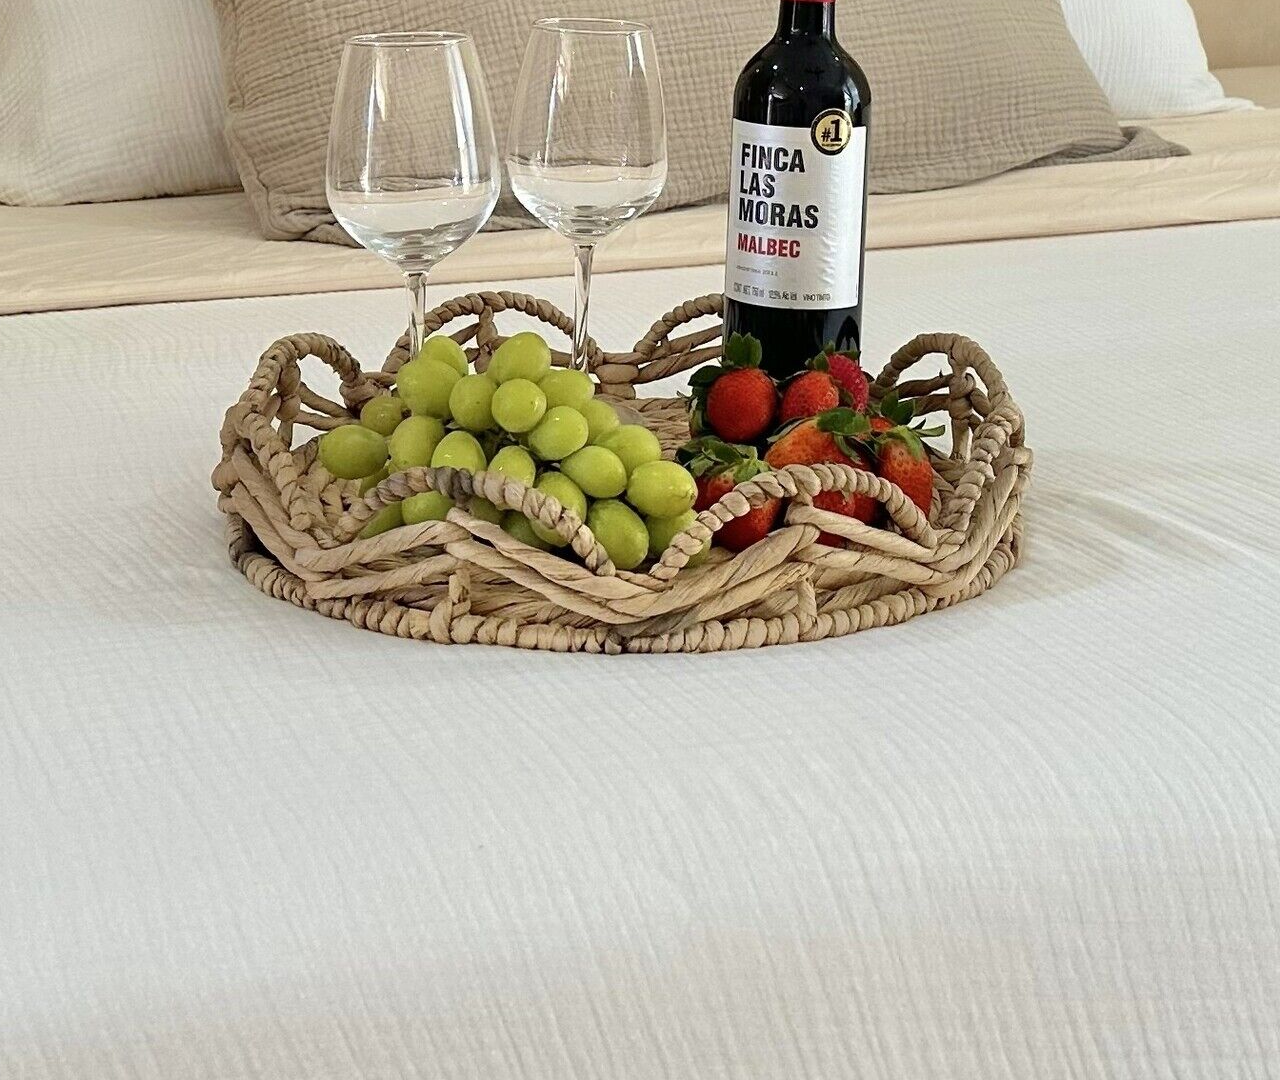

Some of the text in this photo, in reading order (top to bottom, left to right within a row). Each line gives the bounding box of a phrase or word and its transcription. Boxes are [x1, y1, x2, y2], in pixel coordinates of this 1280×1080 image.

[820, 118, 842, 143] #1
[740, 142, 805, 173] FINCA
[739, 170, 776, 199] LAS
[738, 197, 819, 229] MORAS
[737, 233, 801, 258] MALBEC
